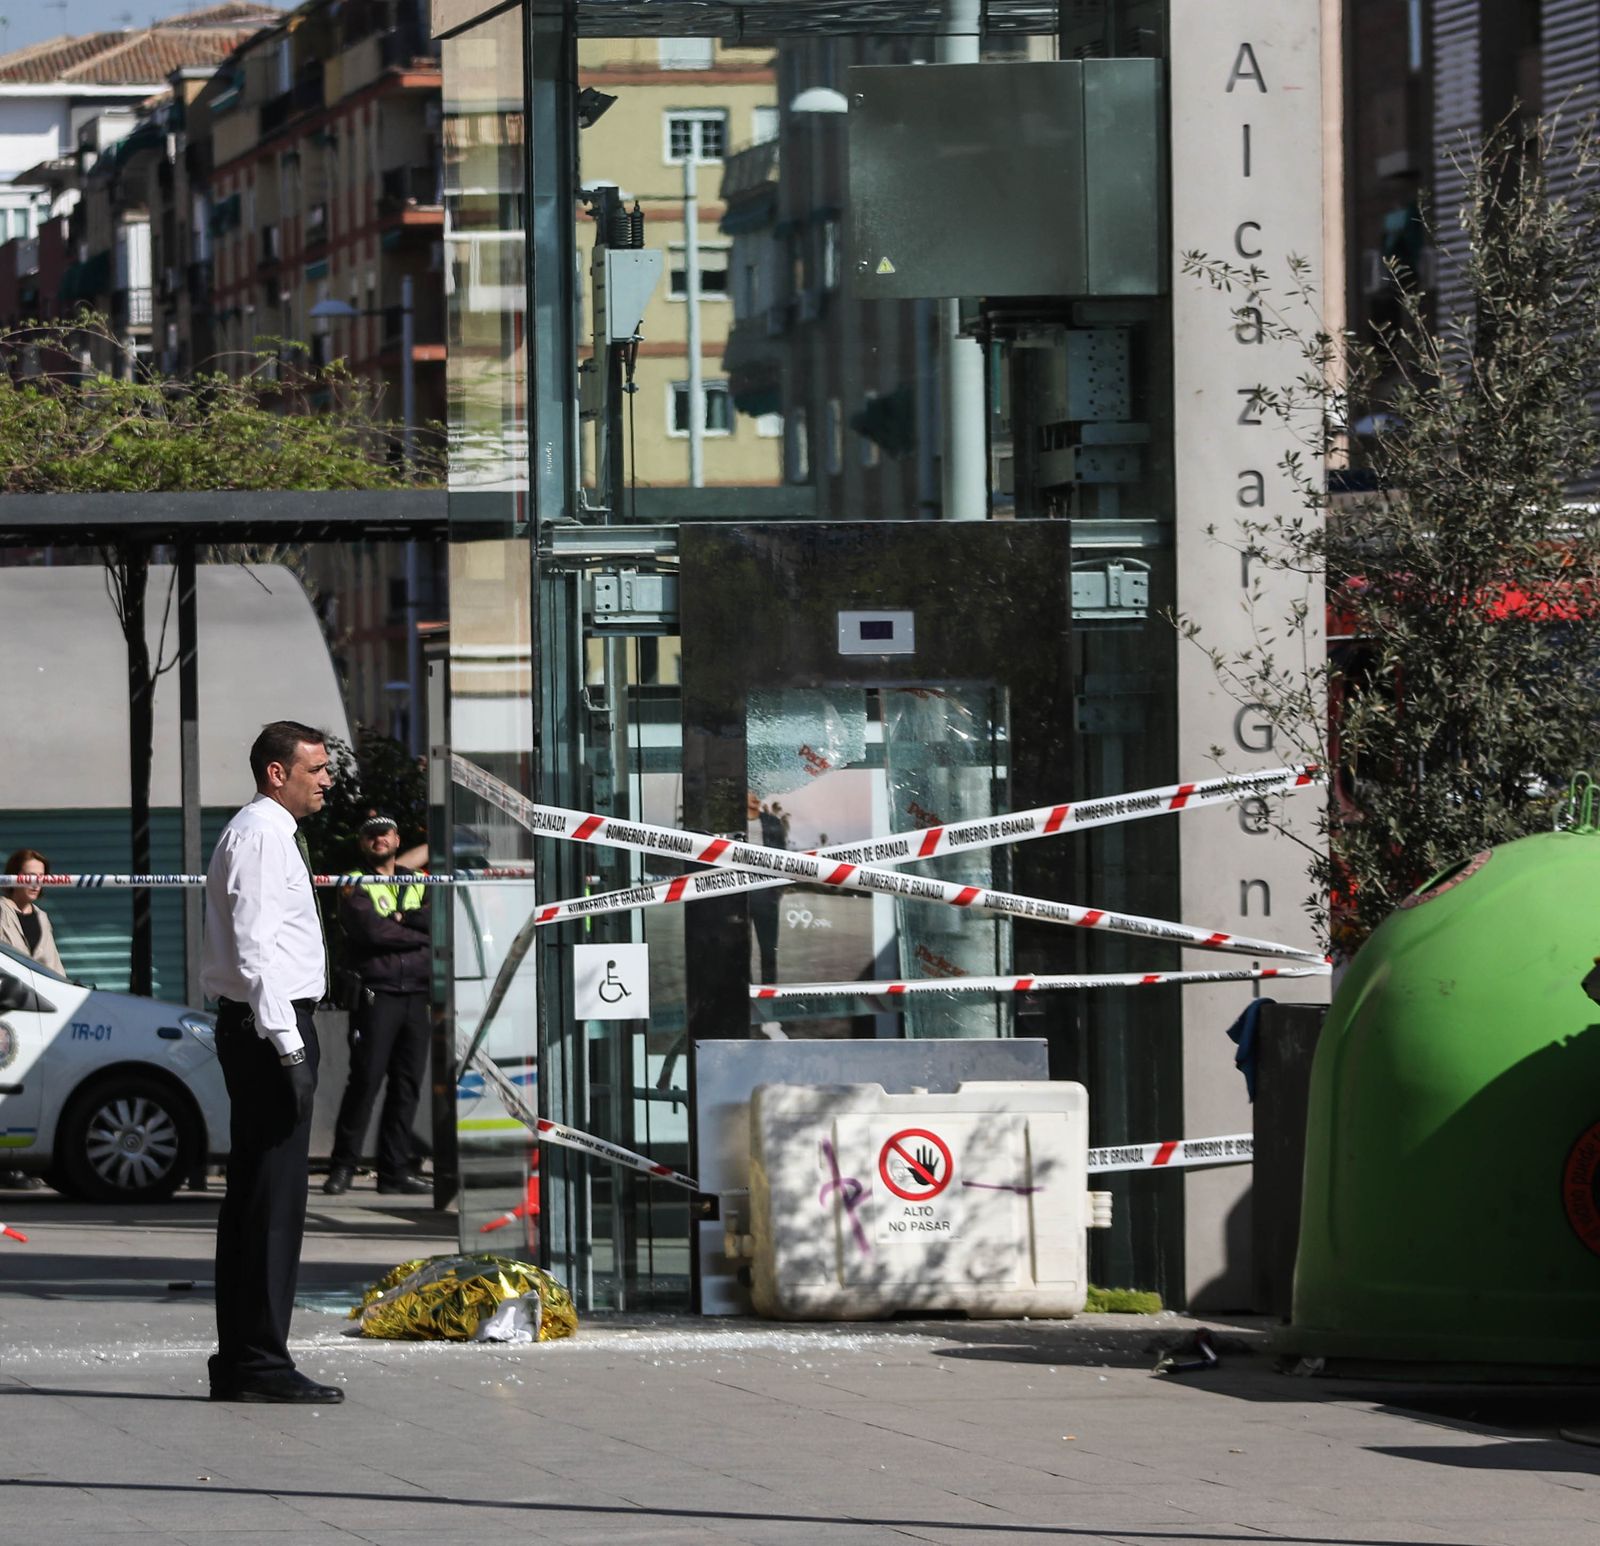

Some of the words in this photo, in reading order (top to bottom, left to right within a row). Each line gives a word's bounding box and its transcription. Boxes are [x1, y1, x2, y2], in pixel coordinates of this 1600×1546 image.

[606, 824, 646, 847] BOMBEROS
[647, 834, 656, 847] DE
[658, 836, 693, 854] GRANADA
[948, 826, 988, 846] BOMBEROS
[990, 824, 1000, 839] DE
[1001, 817, 1035, 836] GRANADA
[864, 847, 874, 862] DE
[875, 839, 910, 860] GRANADA
[732, 847, 772, 869] BOMBEROS
[773, 857, 783, 870] DE
[785, 858, 819, 878] GRANADA
[695, 871, 736, 892] BOMBEROS
[858, 871, 898, 891] BOMBEROS
[899, 879, 910, 893] DE
[910, 881, 945, 900] GRANADA
[71, 1023, 112, 1041] TR-01
[1100, 1150, 1108, 1165] DE
[1184, 1141, 1222, 1158] BOMBEROS
[1225, 1140, 1233, 1156] DE
[903, 1205, 934, 1217] ALTO
[888, 1221, 907, 1232] NO
[911, 1220, 951, 1232] PASAR
